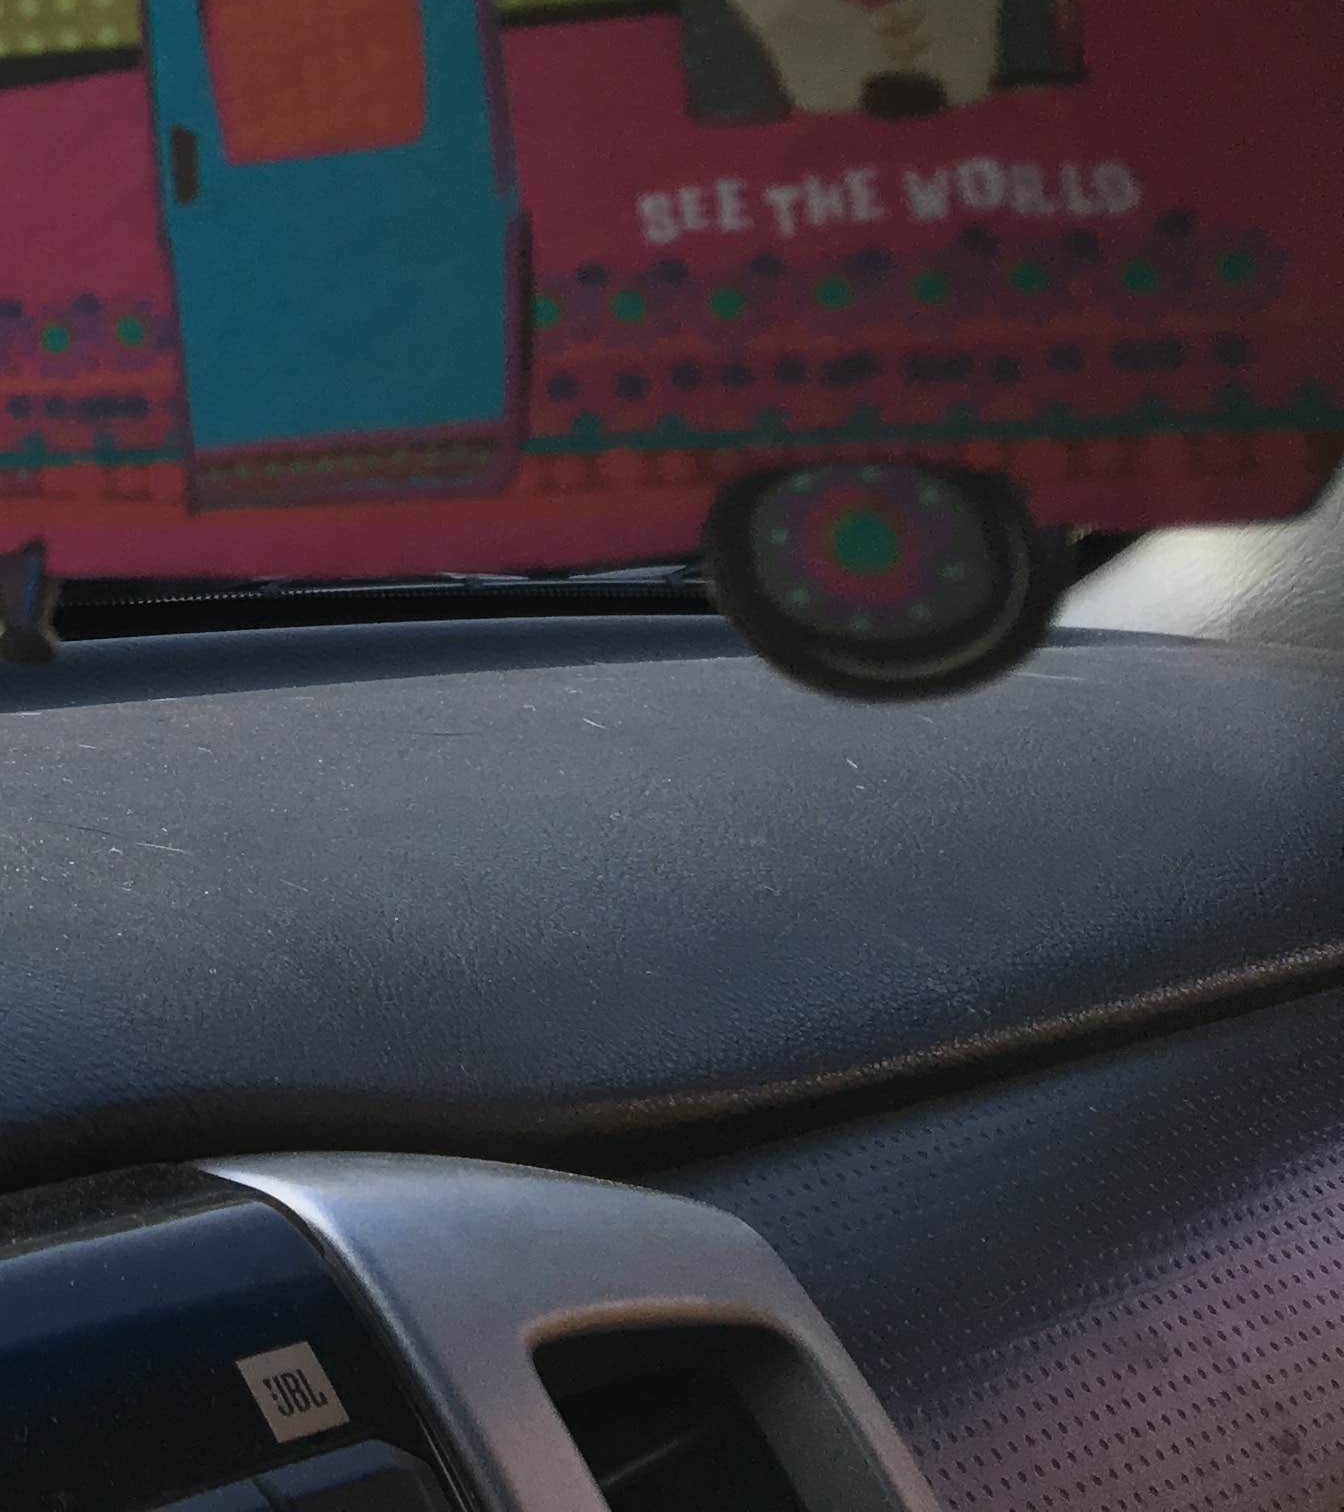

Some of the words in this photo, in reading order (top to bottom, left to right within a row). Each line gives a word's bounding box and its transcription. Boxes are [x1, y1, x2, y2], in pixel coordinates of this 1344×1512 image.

[638, 178, 751, 244] SEE
[766, 169, 885, 239] THE
[904, 158, 1141, 221] WORLD
[263, 1369, 329, 1417] JBL
